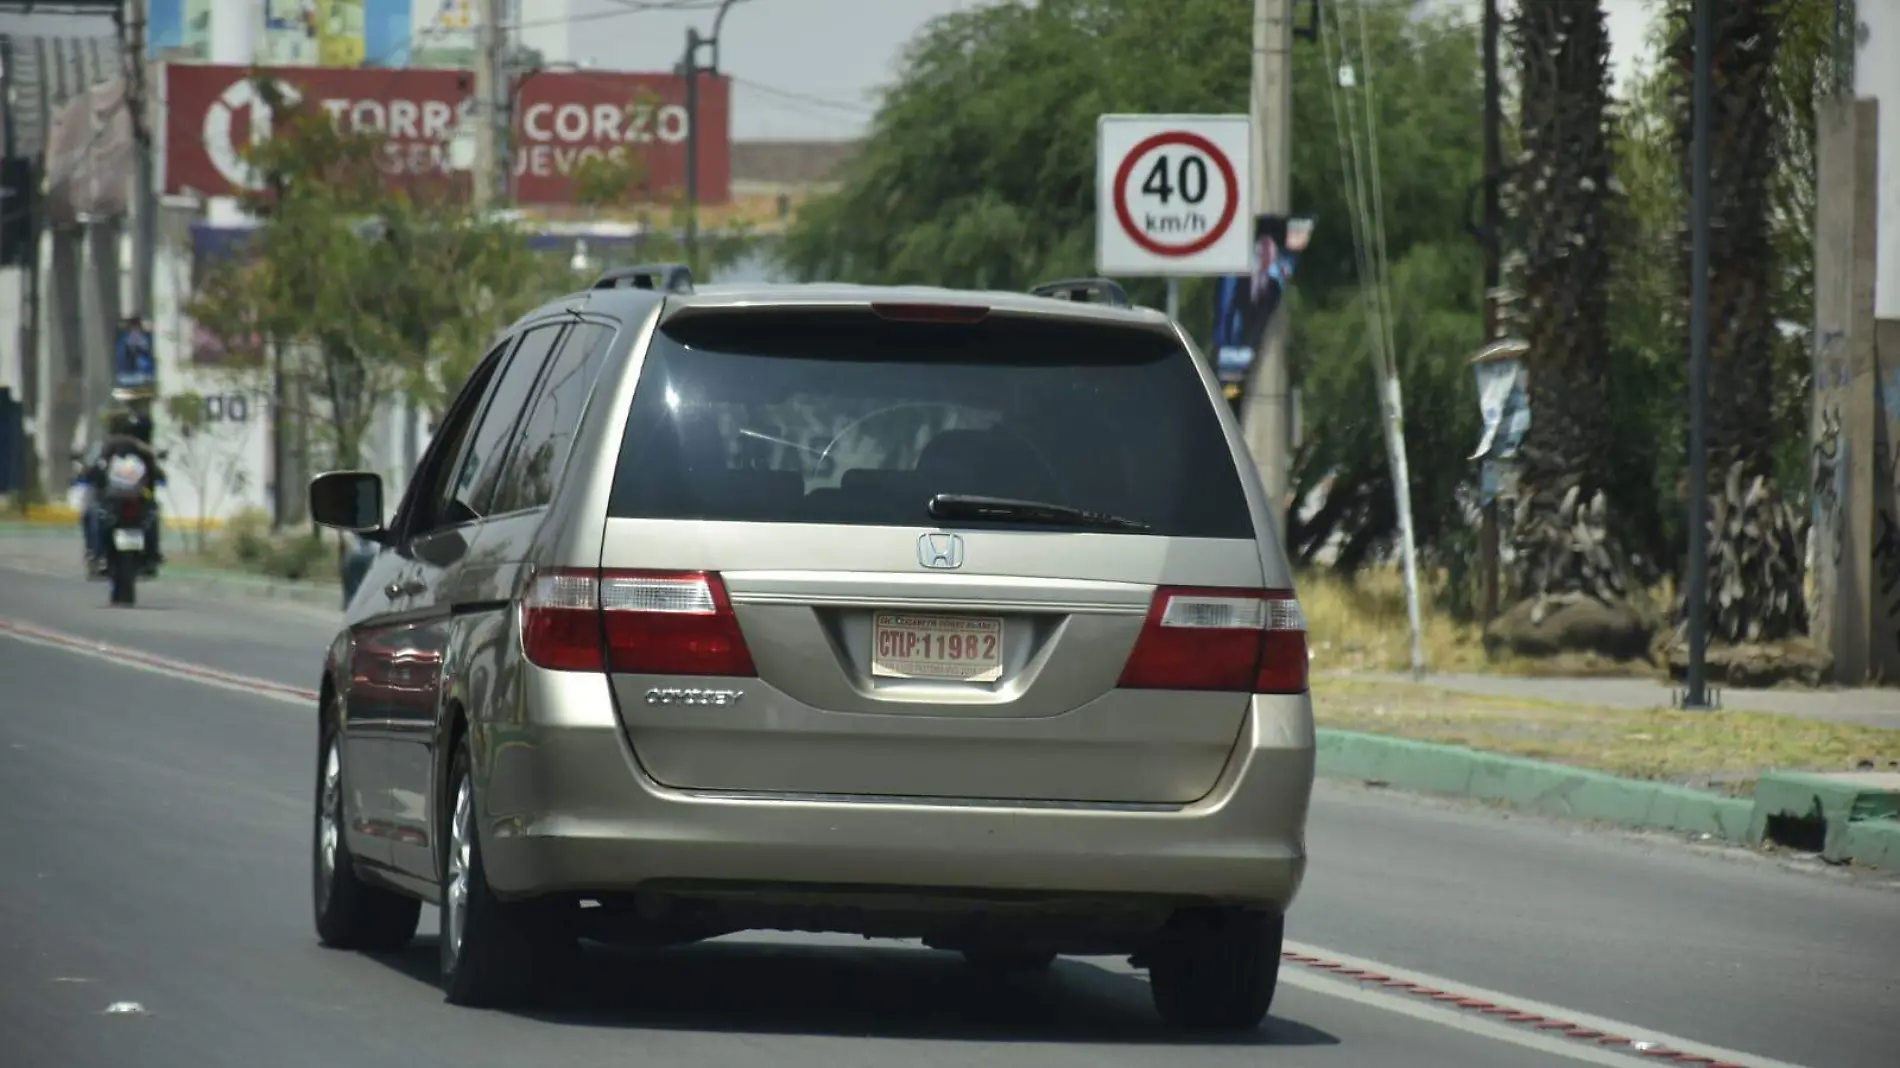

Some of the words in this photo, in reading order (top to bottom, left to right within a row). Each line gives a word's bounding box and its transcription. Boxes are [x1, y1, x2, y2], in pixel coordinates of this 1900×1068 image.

[524, 102, 690, 143] CORZO
[1142, 155, 1208, 204] 40
[1145, 213, 1206, 232] km/h
